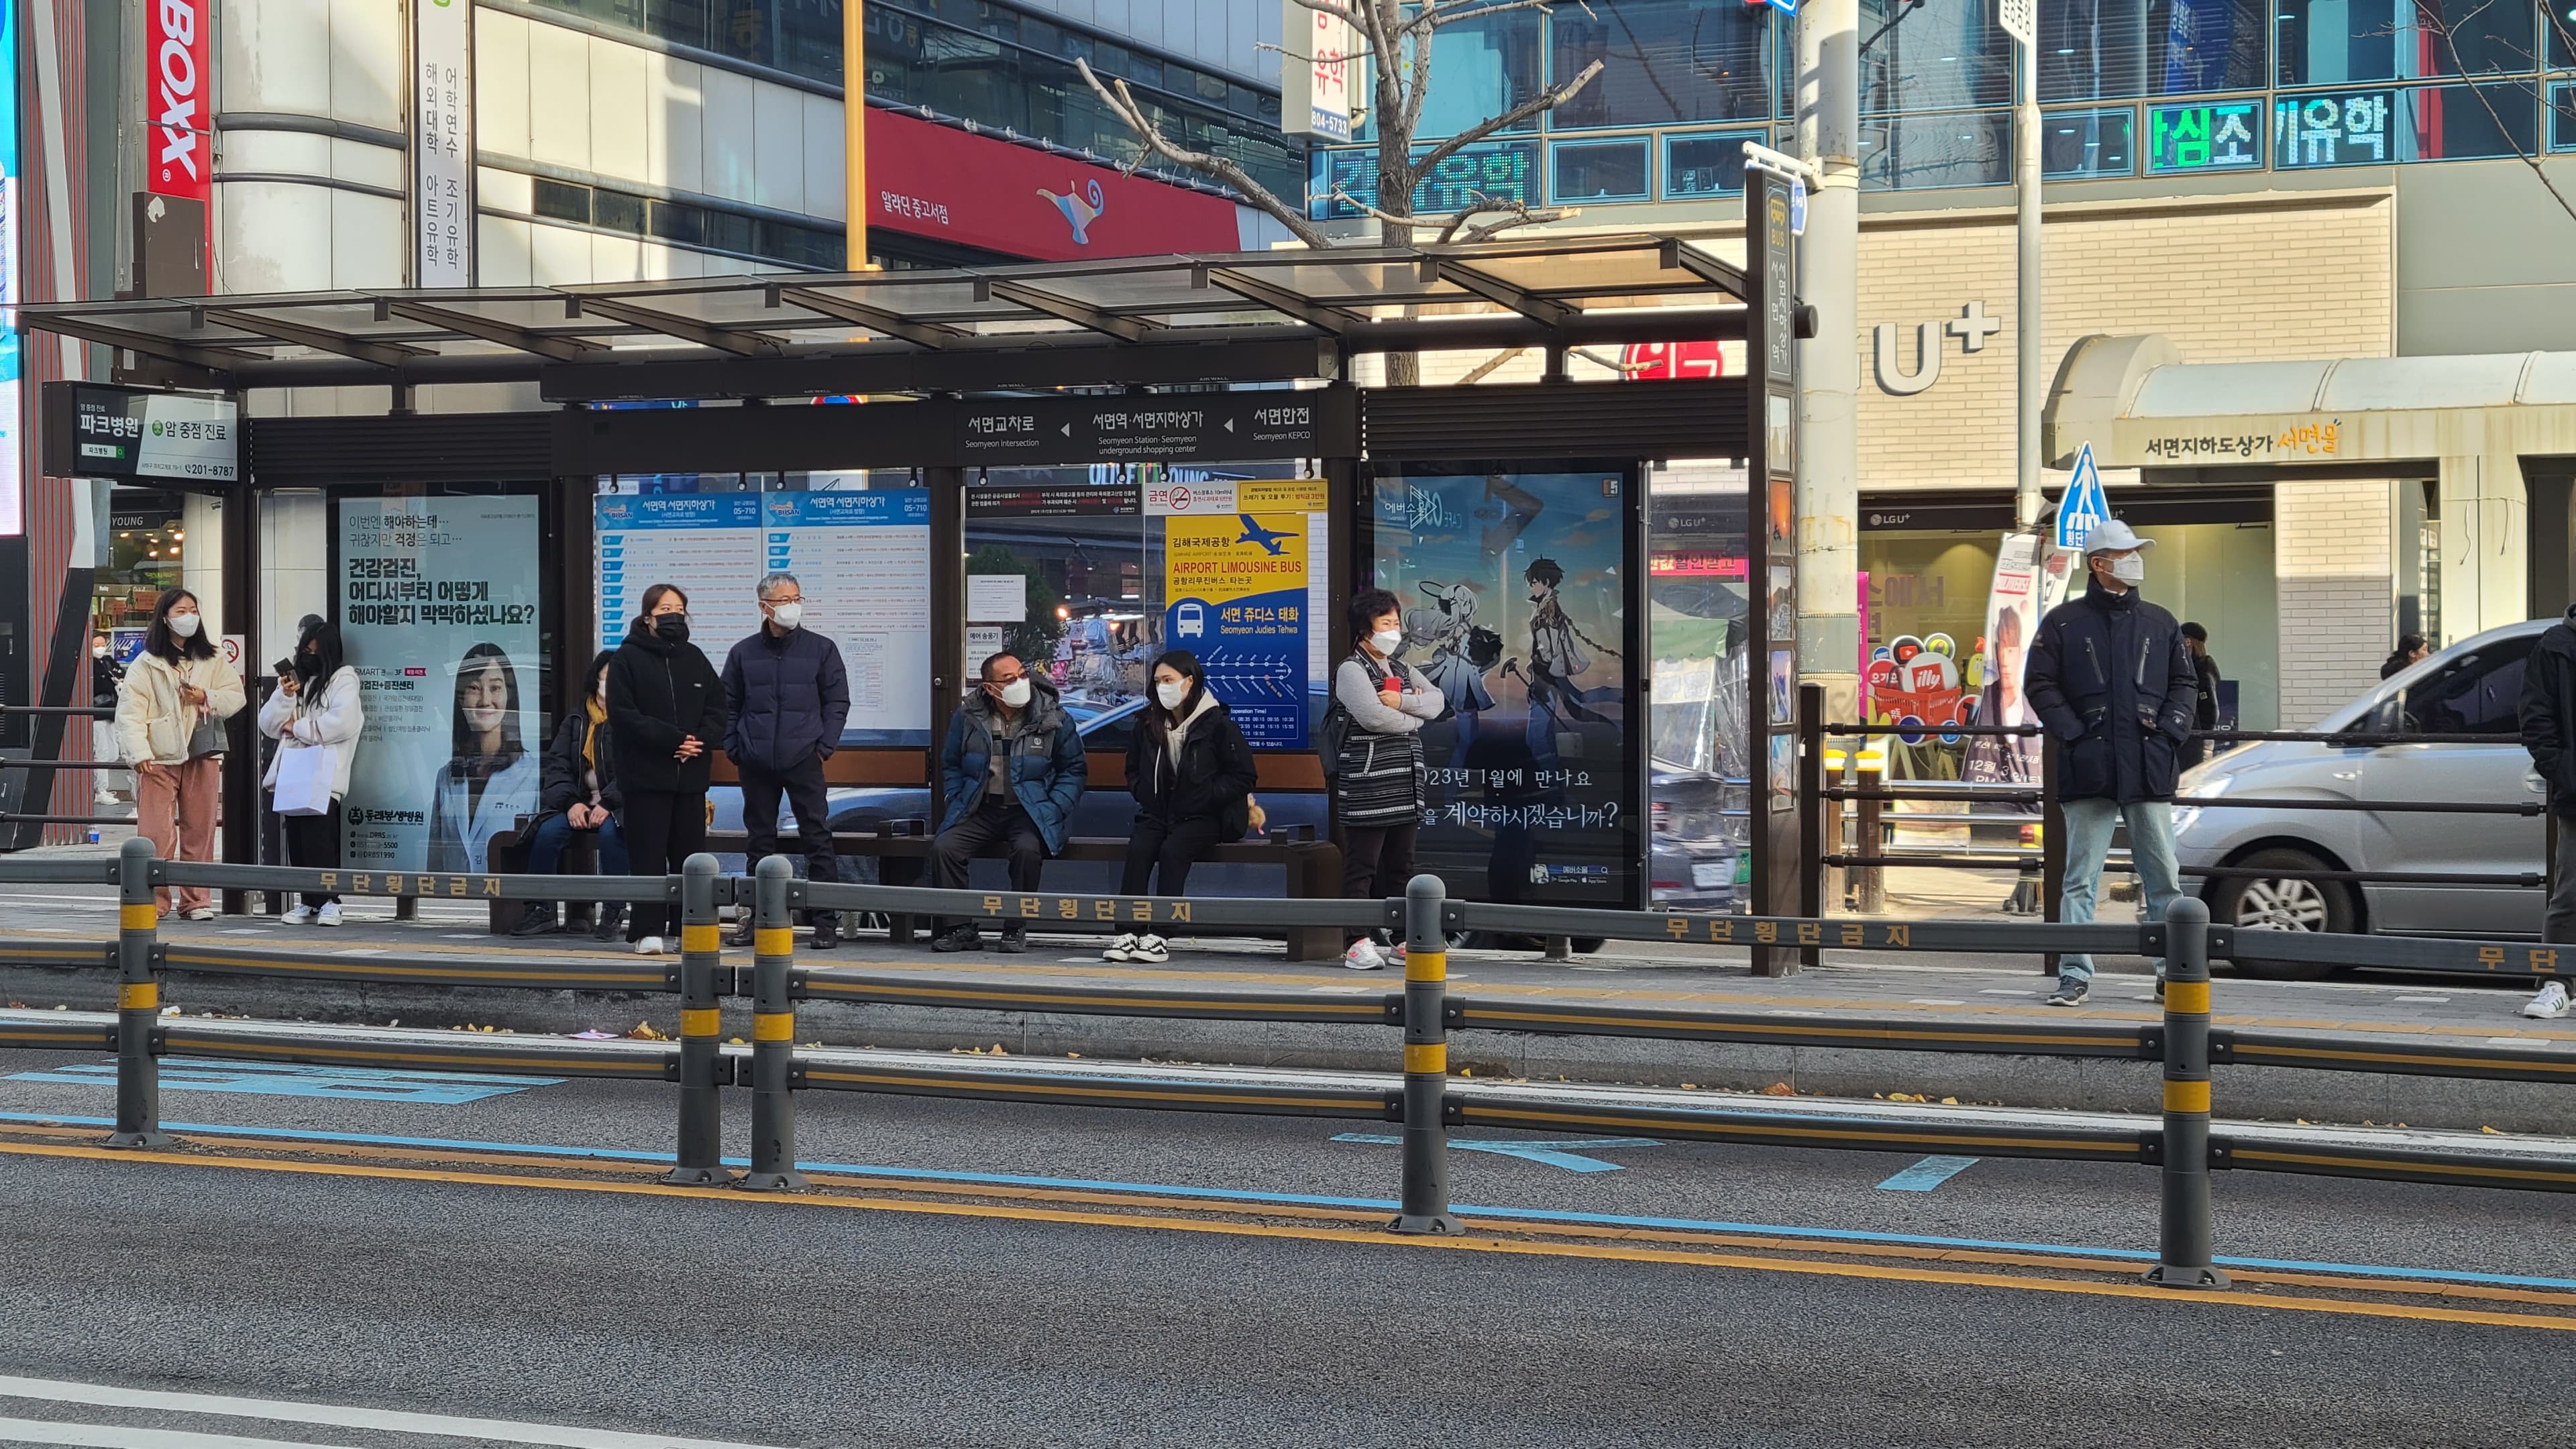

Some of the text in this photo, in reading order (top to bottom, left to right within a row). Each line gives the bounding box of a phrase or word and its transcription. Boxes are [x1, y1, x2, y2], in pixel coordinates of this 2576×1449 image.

[1311, 111, 1347, 134] 804-5733
[426, 62, 439, 267] 해외대학 아트유학
[445, 68, 459, 270] 어학연수 조기유학
[881, 191, 949, 225] 알라딘 중고서점
[1771, 228, 1785, 247] BUS
[1778, 262, 1788, 365] 서면지하상가
[1254, 407, 1309, 426] 서면한전
[80, 414, 139, 438] 파크병원
[165, 421, 227, 441] 암 중점 진료
[967, 415, 1034, 434] 서면교차로
[965, 438, 1039, 449] Seomyeon Intersection
[1097, 436, 1135, 447] Seomyeon
[1252, 431, 1311, 443] Seomyeon KEPCO
[2145, 420, 2341, 459] 서면지하도상가 서면몰
[89, 447, 108, 455] 파크병원
[1098, 445, 1197, 456] underground shopping center
[191, 464, 234, 477] 201-8787
[810, 496, 885, 508] 서면역 서면지하상가
[1148, 490, 1168, 502] 금연
[642, 499, 715, 512] 서면역 서면지하상가
[733, 507, 756, 515] 05-710
[904, 504, 927, 512] 05-710
[111, 517, 144, 527] YOUNG
[349, 515, 381, 529] 이번엔
[349, 533, 391, 547] 귀찮지만
[394, 533, 428, 547] 걱정은
[1173, 537, 1230, 548] 김해국제공항
[348, 557, 421, 581] 건강검진,
[1173, 561, 1302, 574] AIRPORT LIMOUSINE BUS
[1173, 576, 1252, 585] 공항리무진버스 타는곳
[348, 580, 488, 602] 어디서부터 어떻게
[348, 604, 535, 626] 해야할지 막막하셨나요?
[1220, 607, 1299, 623] 서면 쥬디스 태화
[982, 632, 998, 640] 송풍기
[1220, 625, 1298, 635] Seomyeon Judies Tehwa
[1870, 673, 1899, 684] 요기요
[1917, 669, 1941, 690] illy
[1970, 759, 1996, 773] 12월
[1424, 768, 1593, 788] 23년 1월에 만나요
[365, 809, 424, 823] 동래봉생병원
[1423, 801, 1619, 830] 을 계약하시겠습니까?
